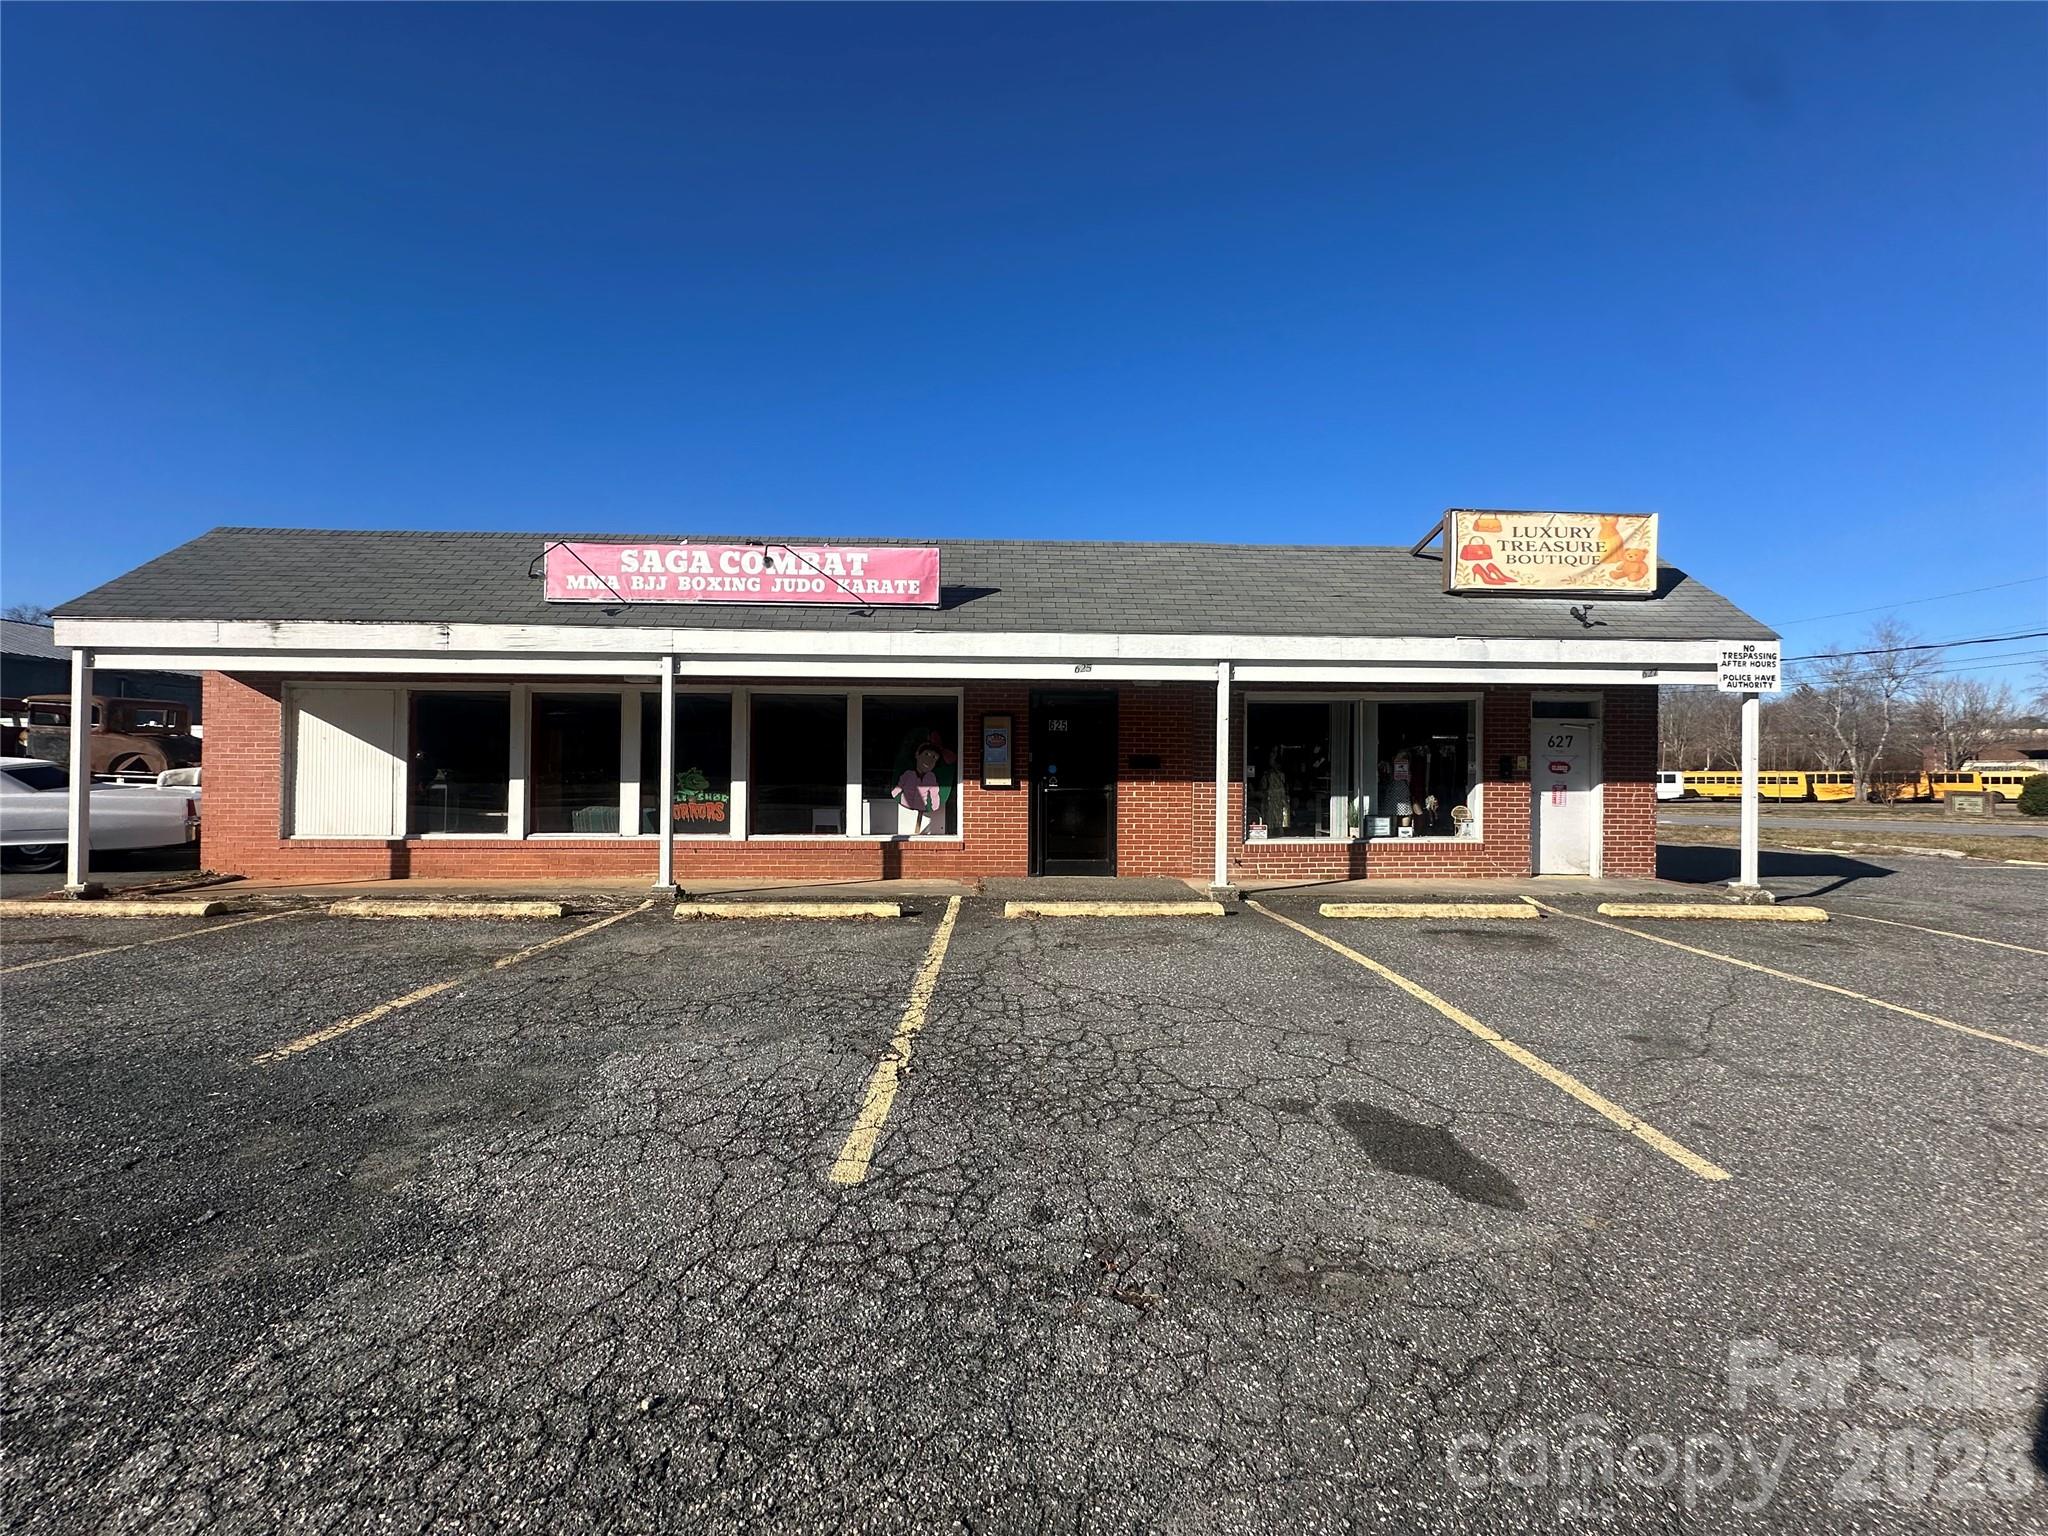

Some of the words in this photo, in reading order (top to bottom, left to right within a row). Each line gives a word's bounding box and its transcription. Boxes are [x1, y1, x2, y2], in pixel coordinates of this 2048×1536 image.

[1512, 526, 1595, 539] LUXURY
[1497, 540, 1607, 553] TREASURE
[620, 549, 714, 574] SAGA
[719, 551, 868, 577] COMBAT
[1506, 554, 1600, 567] BOUTIQUE
[566, 575, 620, 590] MMA
[631, 576, 668, 591] BJJ
[678, 576, 761, 592] BOXING
[771, 577, 826, 593] JUDO
[836, 579, 921, 594] KARATE
[1743, 644, 1756, 652] NO
[1722, 651, 1777, 660] TRESPASSING
[1074, 663, 1092, 673] 625
[1721, 660, 1747, 668] AFTER
[1750, 660, 1777, 668] HOURS
[1754, 674, 1777, 682] HAVE
[1726, 681, 1773, 689] AUTHORITY
[1547, 735, 1573, 748] 627
[673, 802, 725, 822] ORRORS
